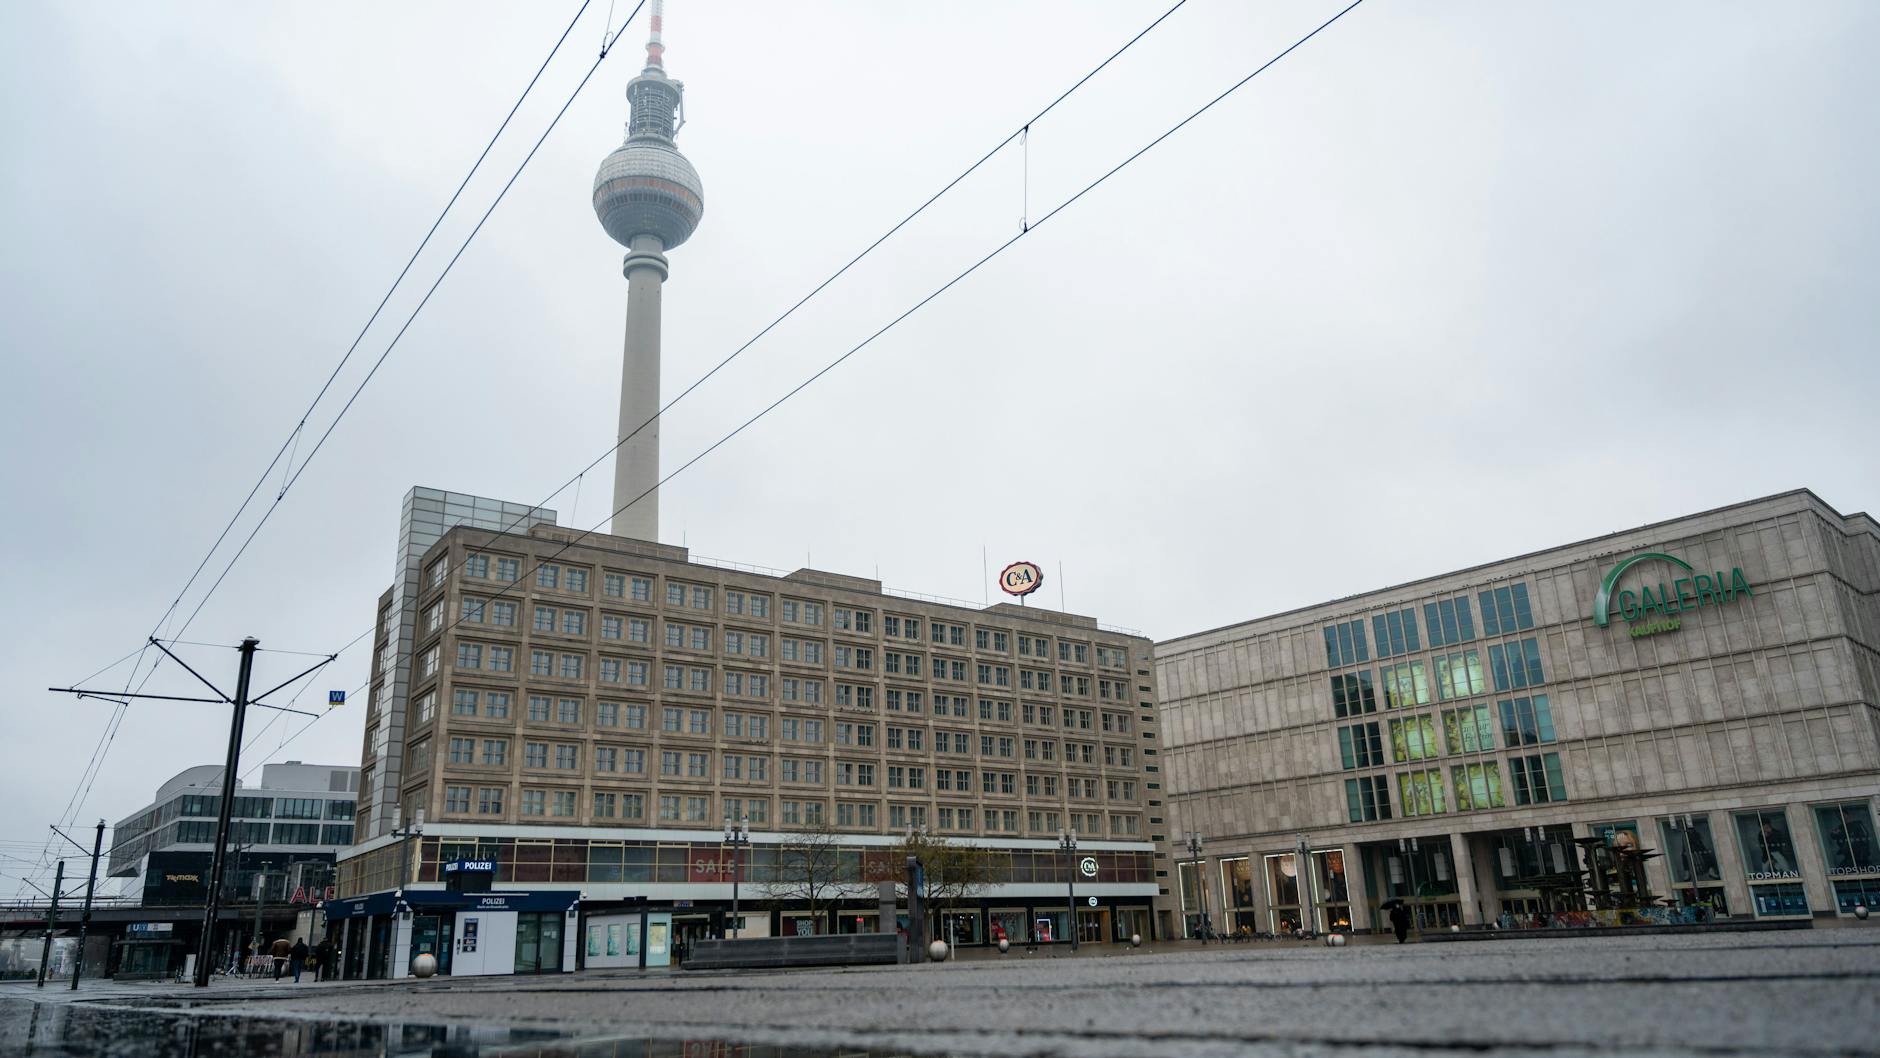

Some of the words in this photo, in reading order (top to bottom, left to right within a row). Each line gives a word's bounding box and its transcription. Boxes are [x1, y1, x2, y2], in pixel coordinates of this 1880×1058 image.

[1006, 568, 1033, 587] C&A
[1618, 567, 1753, 622] GALERIA
[464, 861, 492, 871] POLIZEI
[695, 858, 735, 874] SALE
[1749, 870, 1799, 881] TOPMAN
[482, 897, 505, 905] POLIZEI
